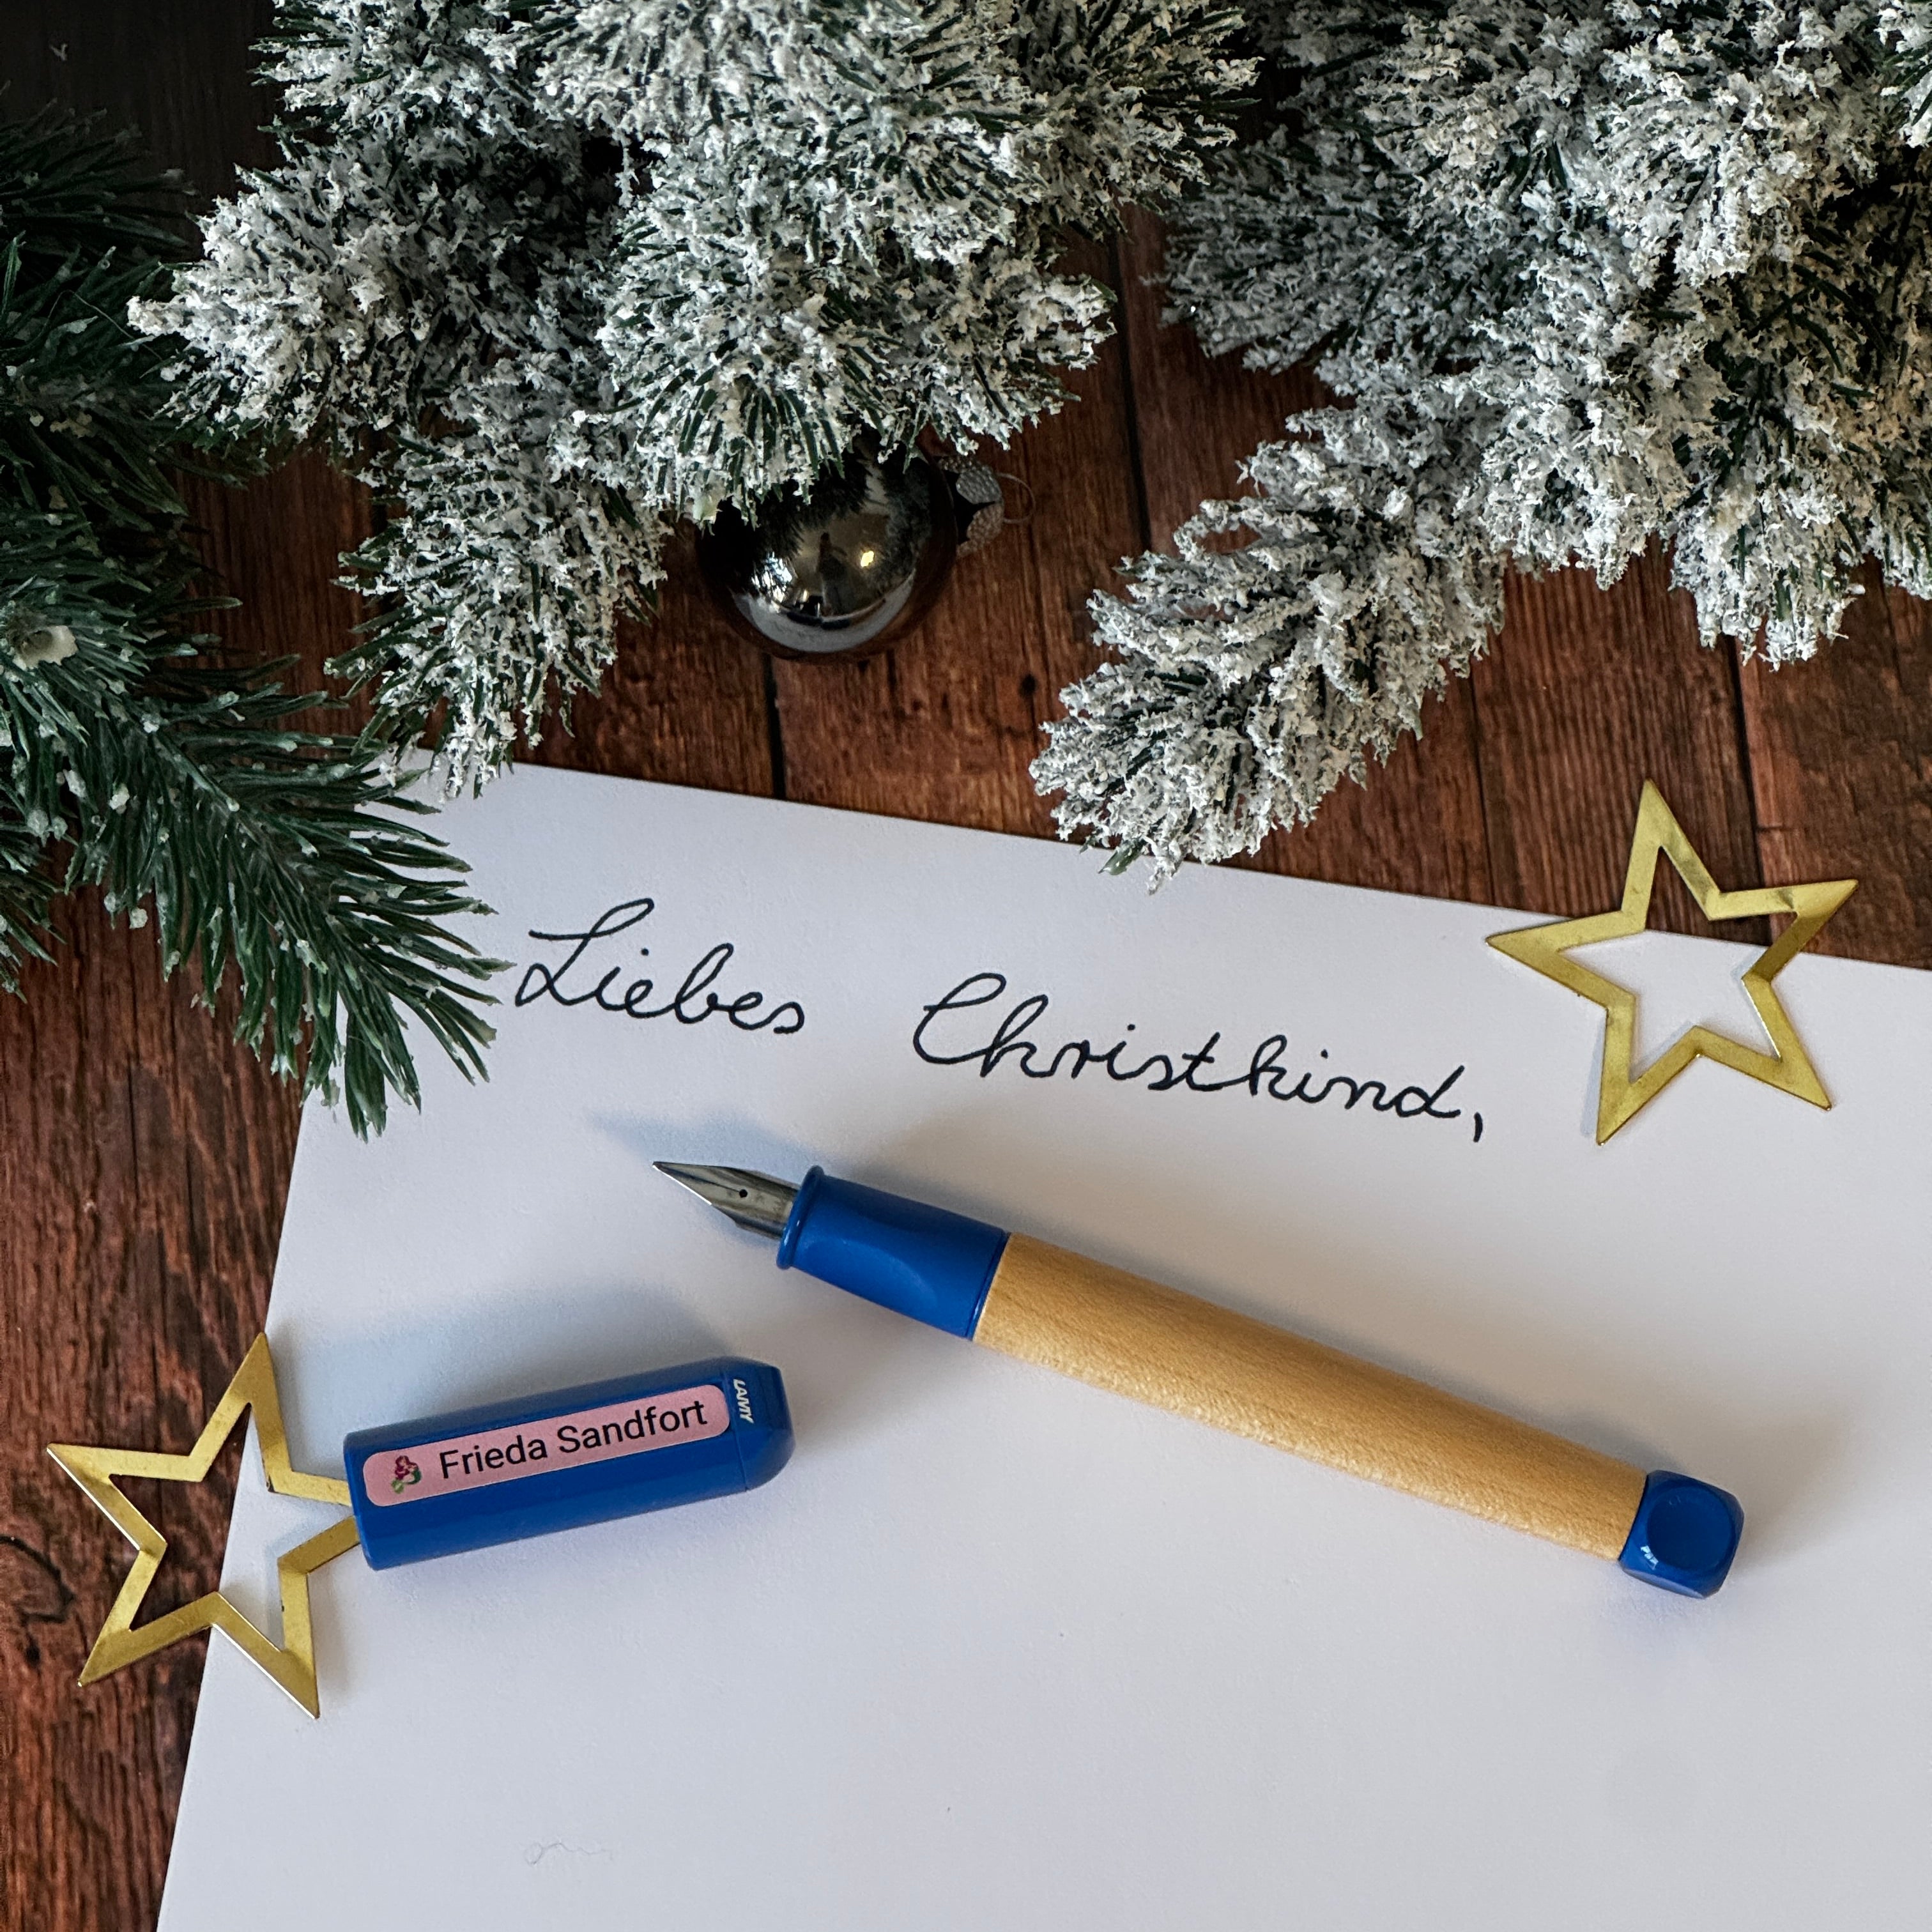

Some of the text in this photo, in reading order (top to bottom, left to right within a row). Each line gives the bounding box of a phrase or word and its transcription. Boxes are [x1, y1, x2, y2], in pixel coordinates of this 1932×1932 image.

[514, 898, 1483, 1142] Liebes Christkind,
[439, 1400, 708, 1479] Frieda Sandfort
[733, 1379, 755, 1423] LAMY
